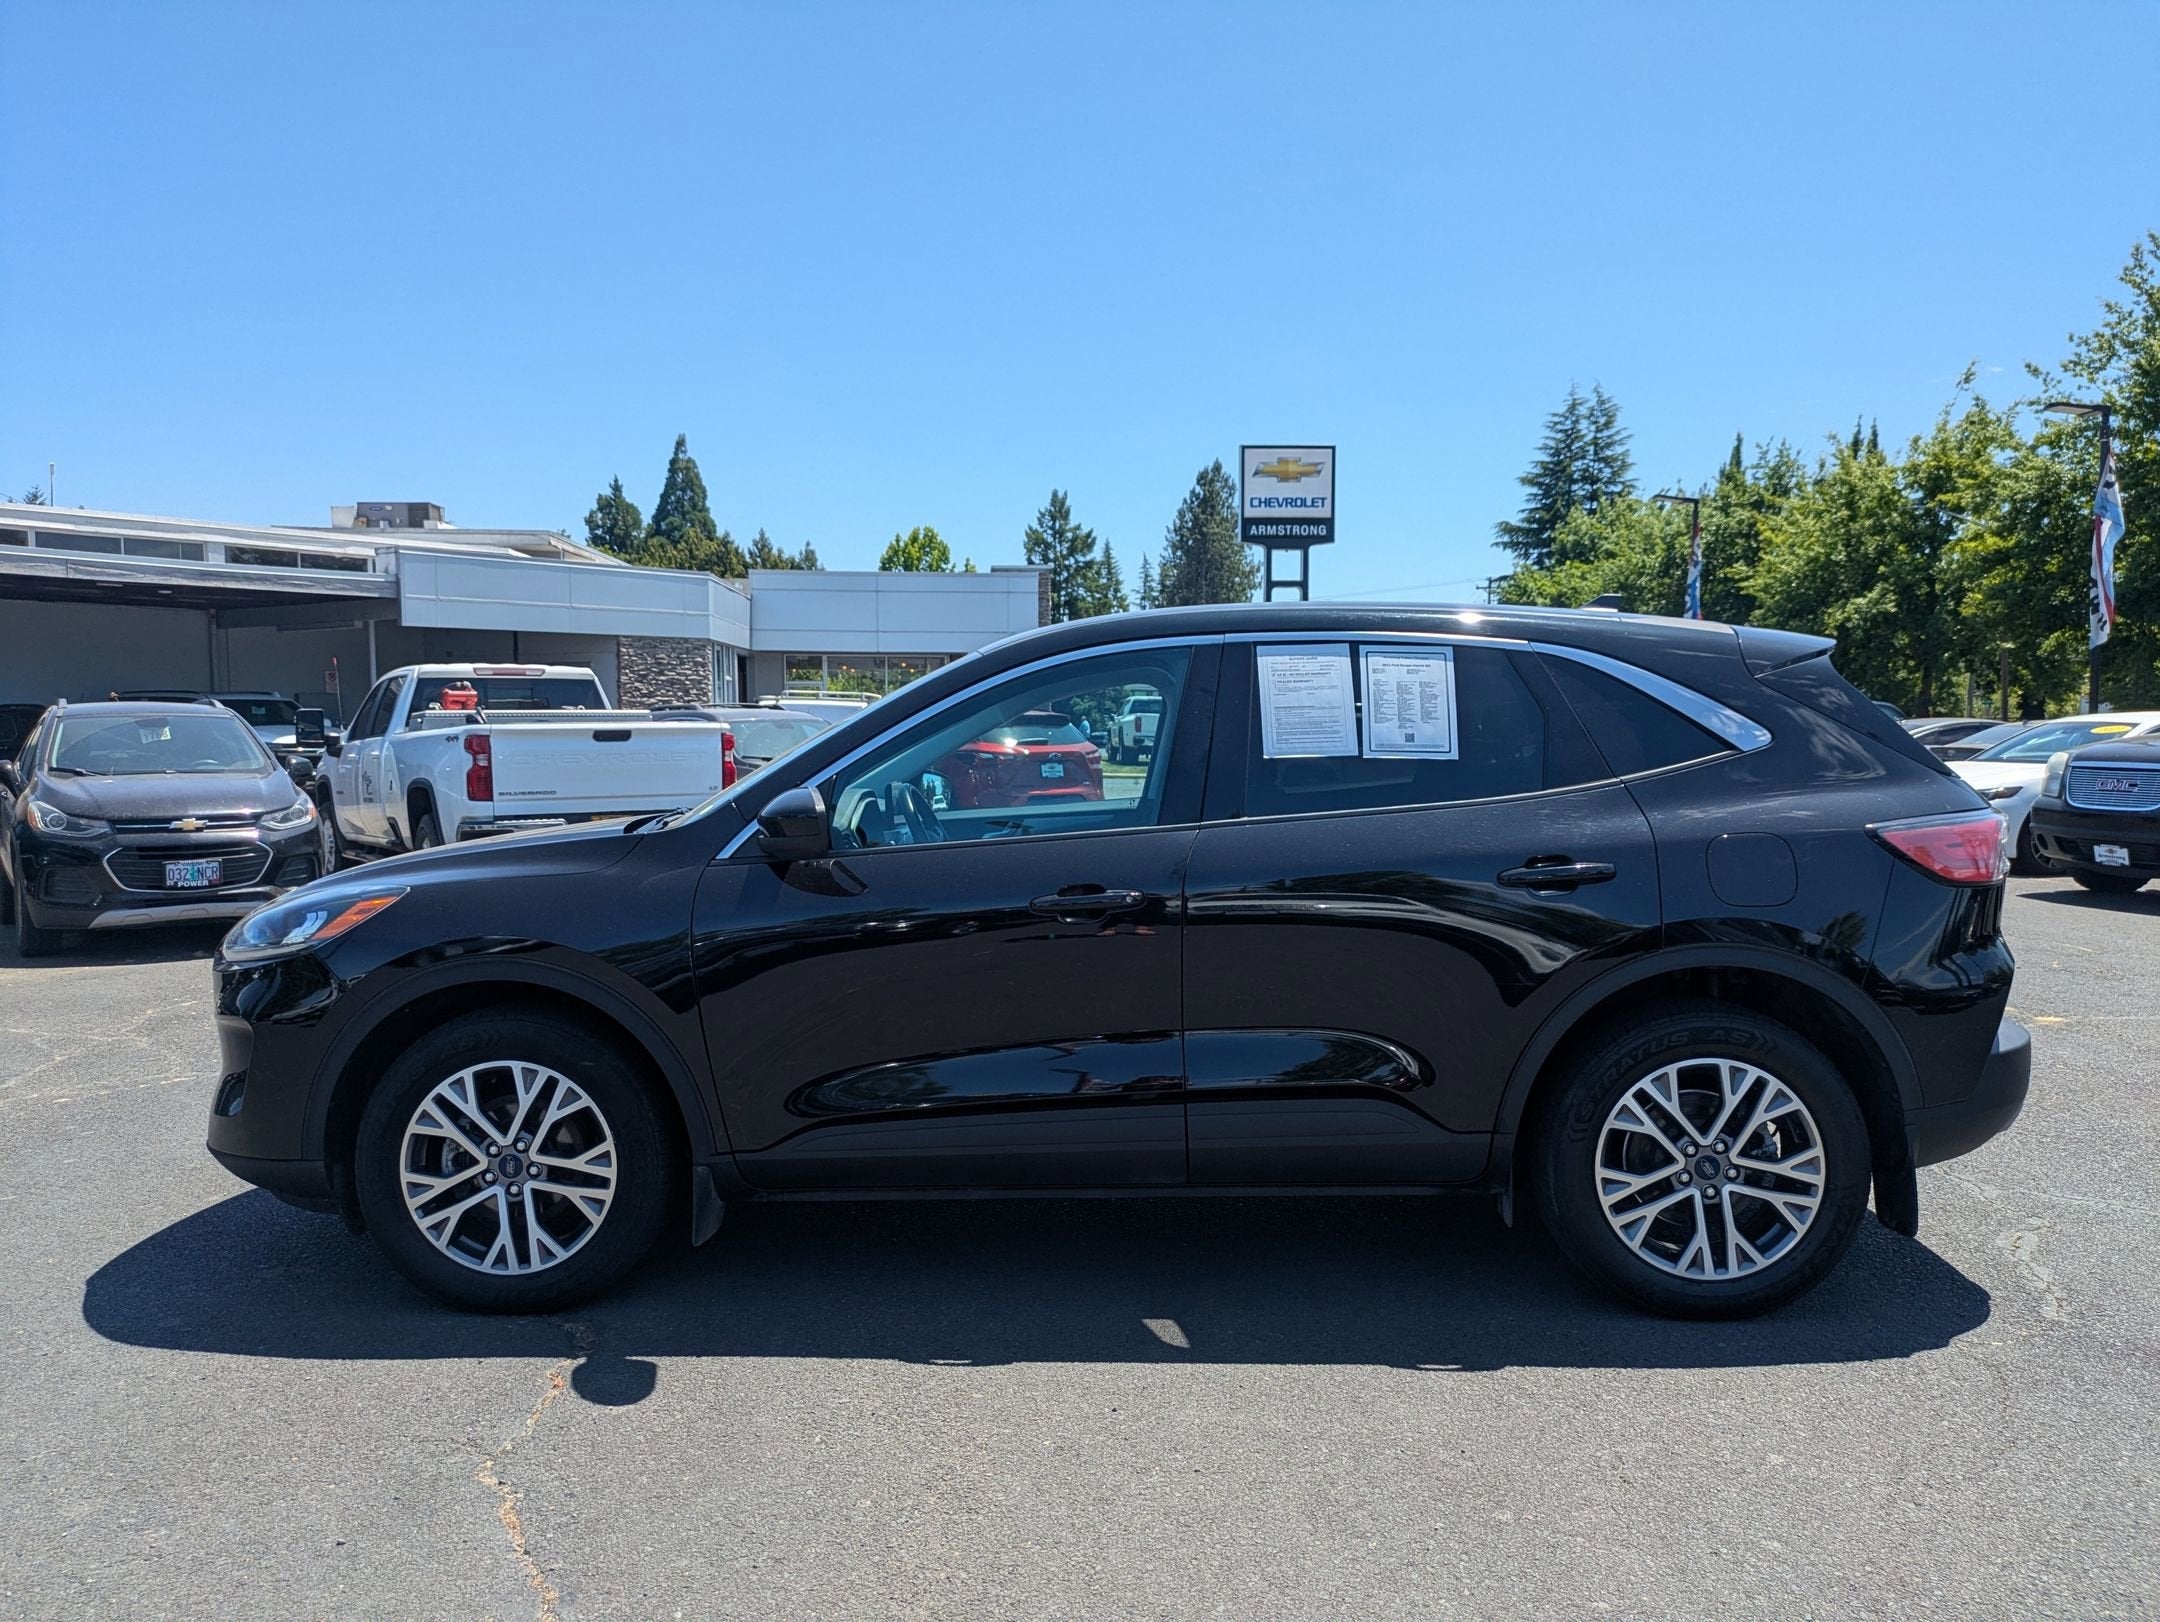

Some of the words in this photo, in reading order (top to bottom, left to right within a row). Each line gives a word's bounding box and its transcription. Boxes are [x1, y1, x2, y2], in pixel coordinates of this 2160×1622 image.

[1249, 496, 1327, 508] CHEVROLET
[1250, 524, 1327, 536] ARMSTRONG
[2095, 778, 2138, 792] GMC
[168, 868, 189, 881] 032
[197, 866, 219, 880] NCR
